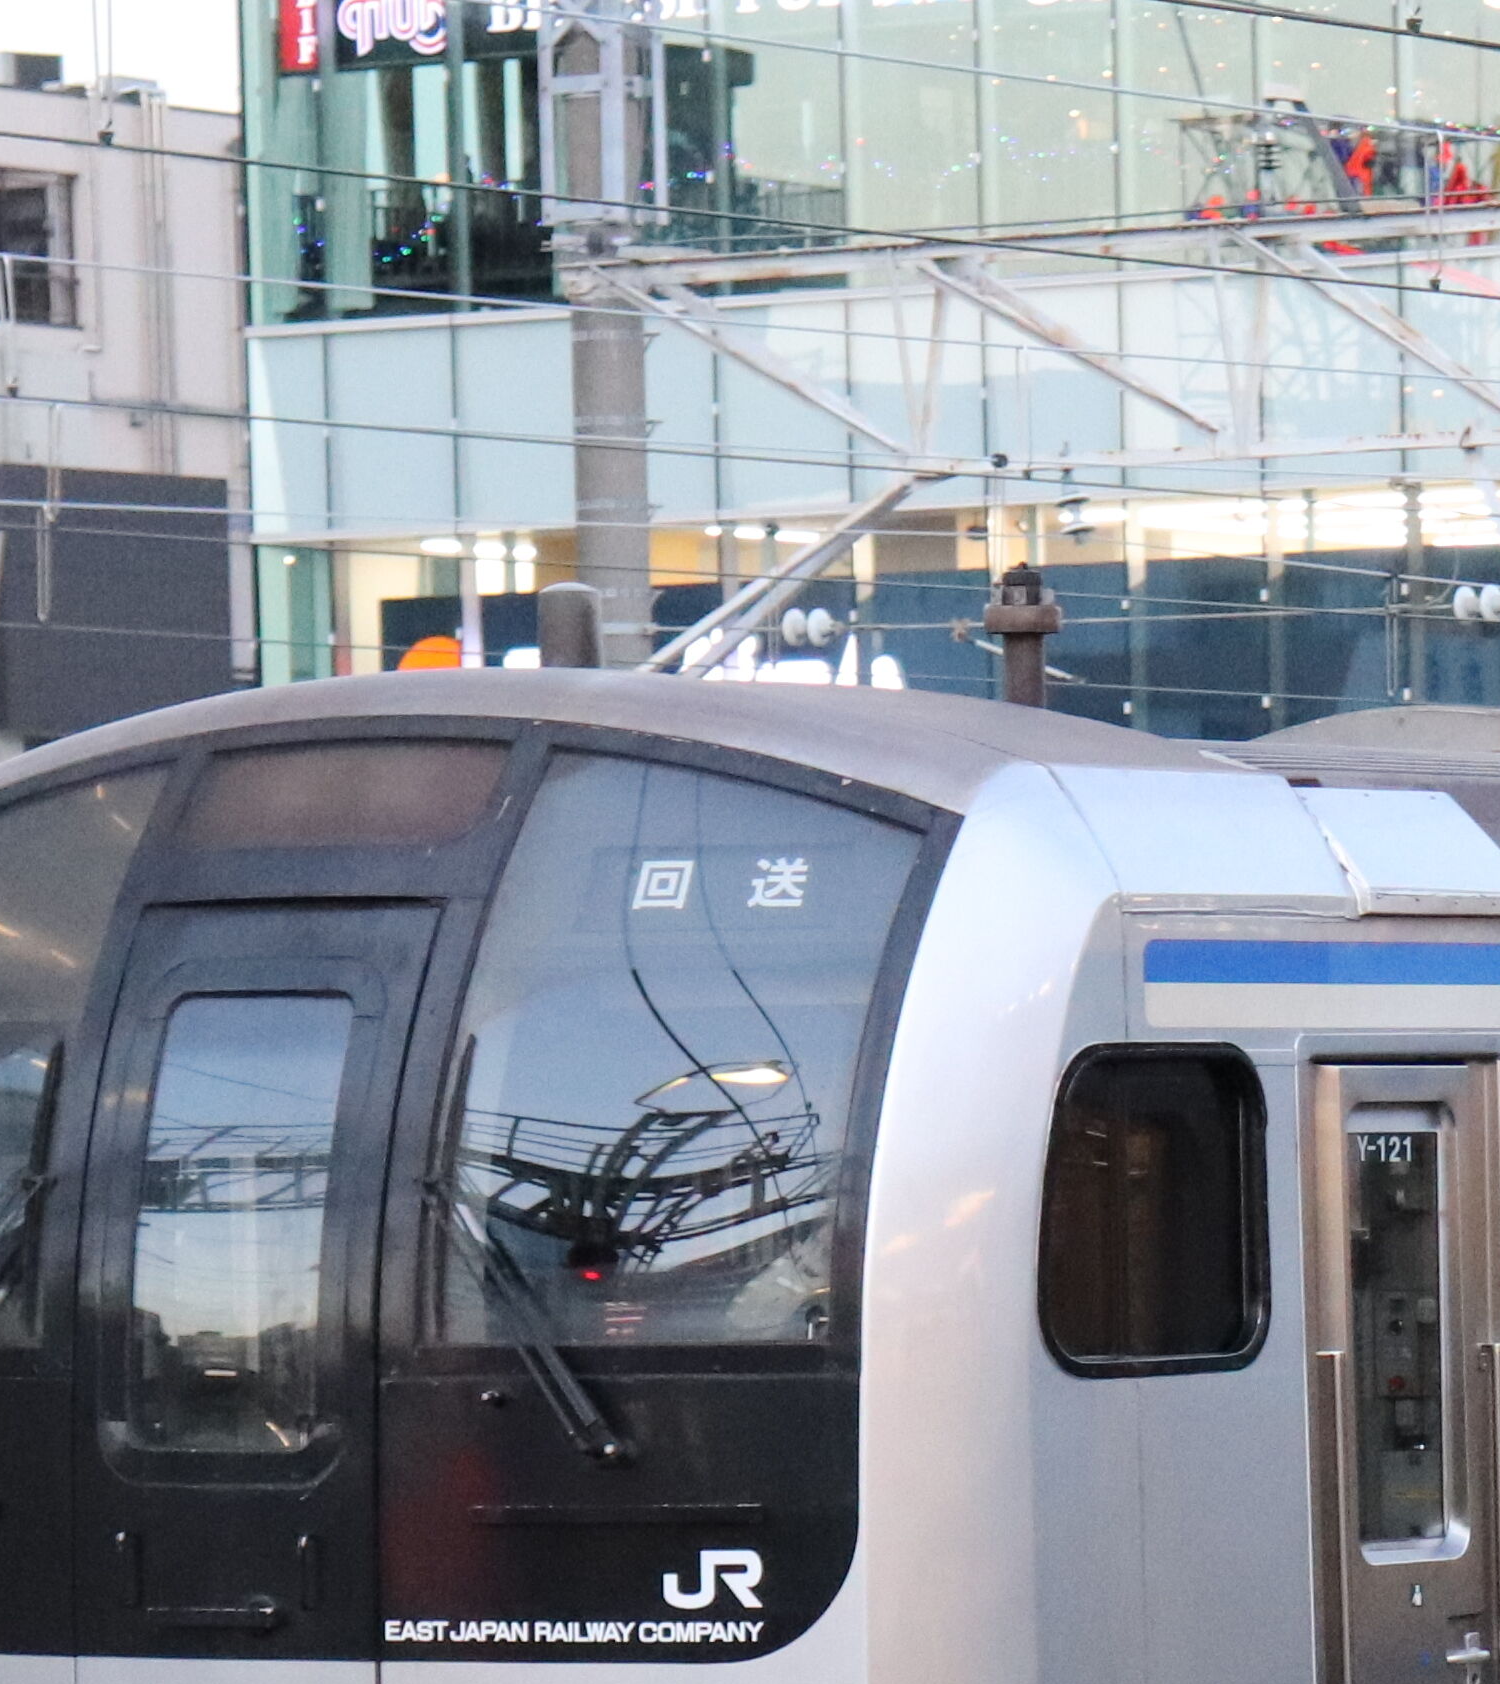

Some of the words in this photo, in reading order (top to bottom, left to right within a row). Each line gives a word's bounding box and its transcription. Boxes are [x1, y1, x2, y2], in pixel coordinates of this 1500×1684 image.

[632, 857, 809, 910] 回送
[1357, 1135, 1412, 1162] Y-121
[662, 1549, 763, 1610] JR
[384, 1620, 448, 1643] EAST
[449, 1620, 529, 1643] JAPAN
[534, 1620, 635, 1643] RAILWAY
[638, 1620, 764, 1643] COMPANY
